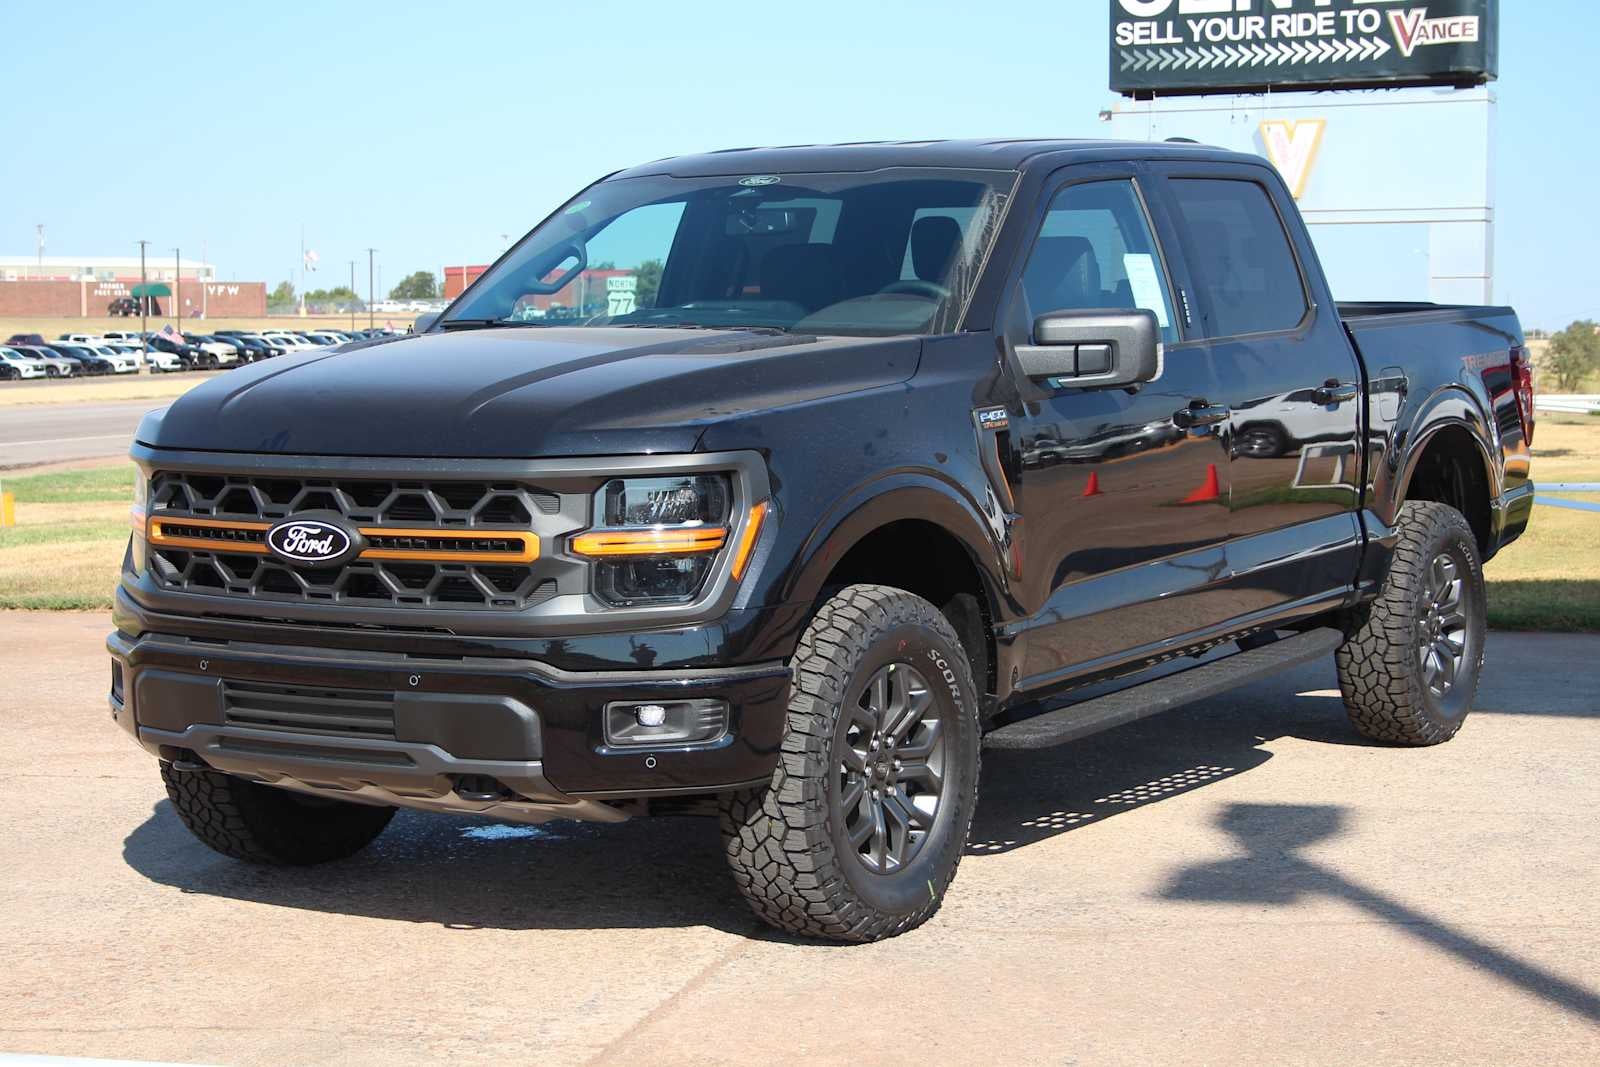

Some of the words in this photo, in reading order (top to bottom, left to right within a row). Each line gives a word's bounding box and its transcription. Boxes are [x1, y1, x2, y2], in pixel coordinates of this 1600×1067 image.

[1115, 21, 1183, 46] SELL
[1187, 16, 1266, 42] YOUR
[1271, 11, 1335, 38] RIDE
[1340, 8, 1381, 34] TO
[207, 284, 240, 297] VFW
[608, 279, 635, 288] NORTH
[610, 298, 632, 314] 77
[283, 525, 334, 555] Ford
